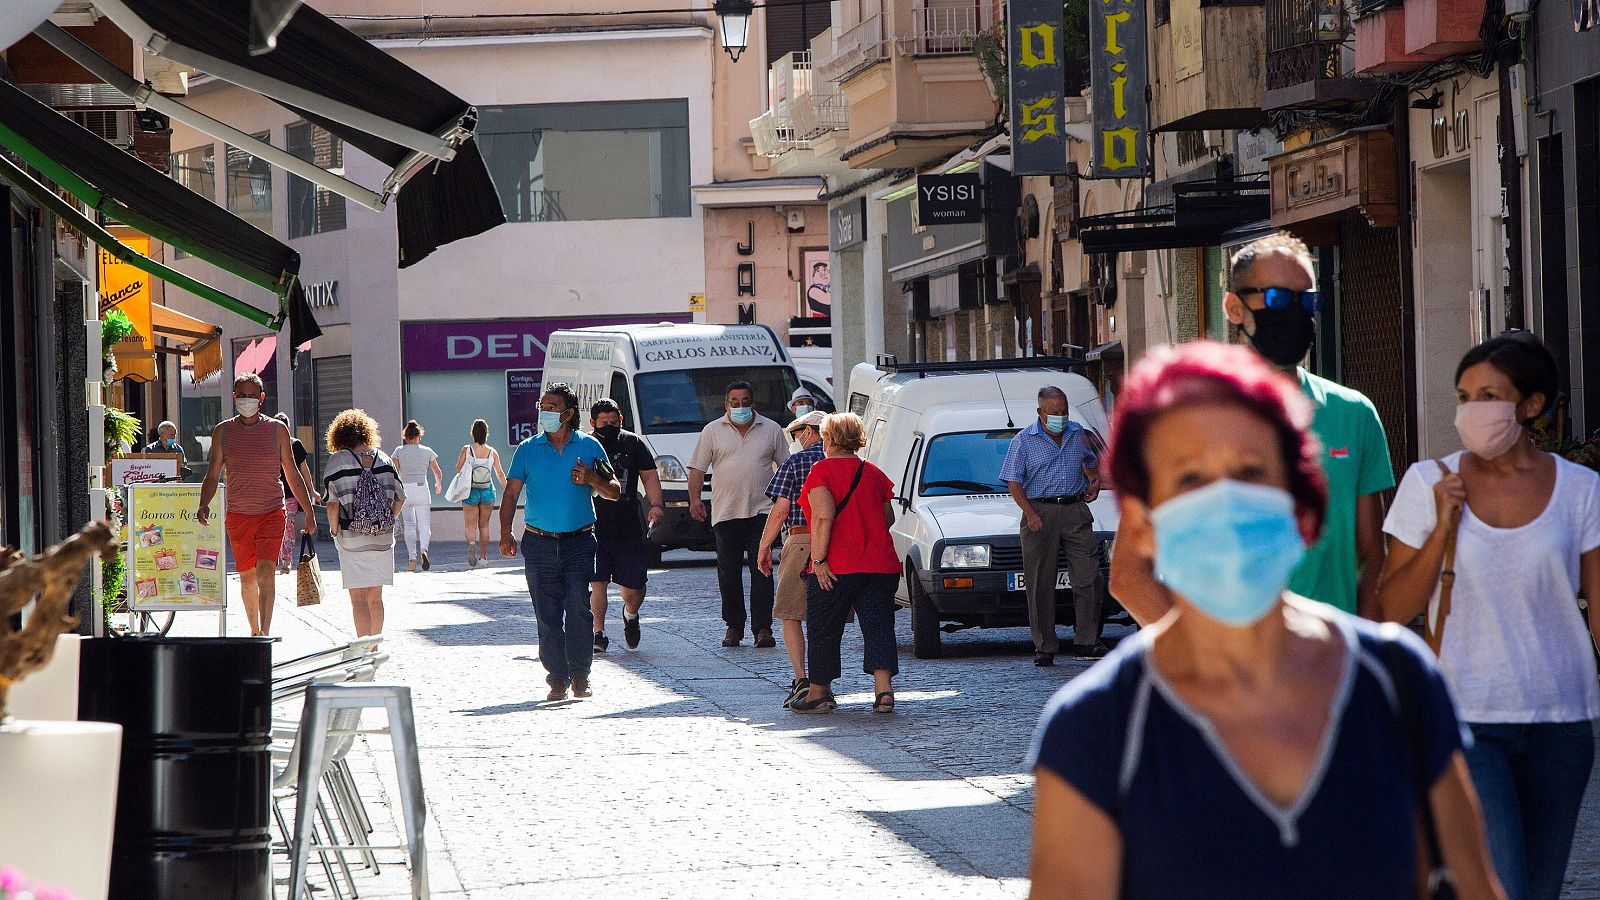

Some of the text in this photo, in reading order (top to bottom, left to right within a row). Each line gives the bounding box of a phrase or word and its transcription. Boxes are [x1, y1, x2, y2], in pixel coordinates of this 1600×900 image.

[1101, 0, 1139, 170] rio
[922, 185, 975, 201] YSISI
[933, 210, 966, 218] woman
[645, 345, 773, 362] CARLOS ARRANZ
[140, 508, 217, 522] Bonos Rego
